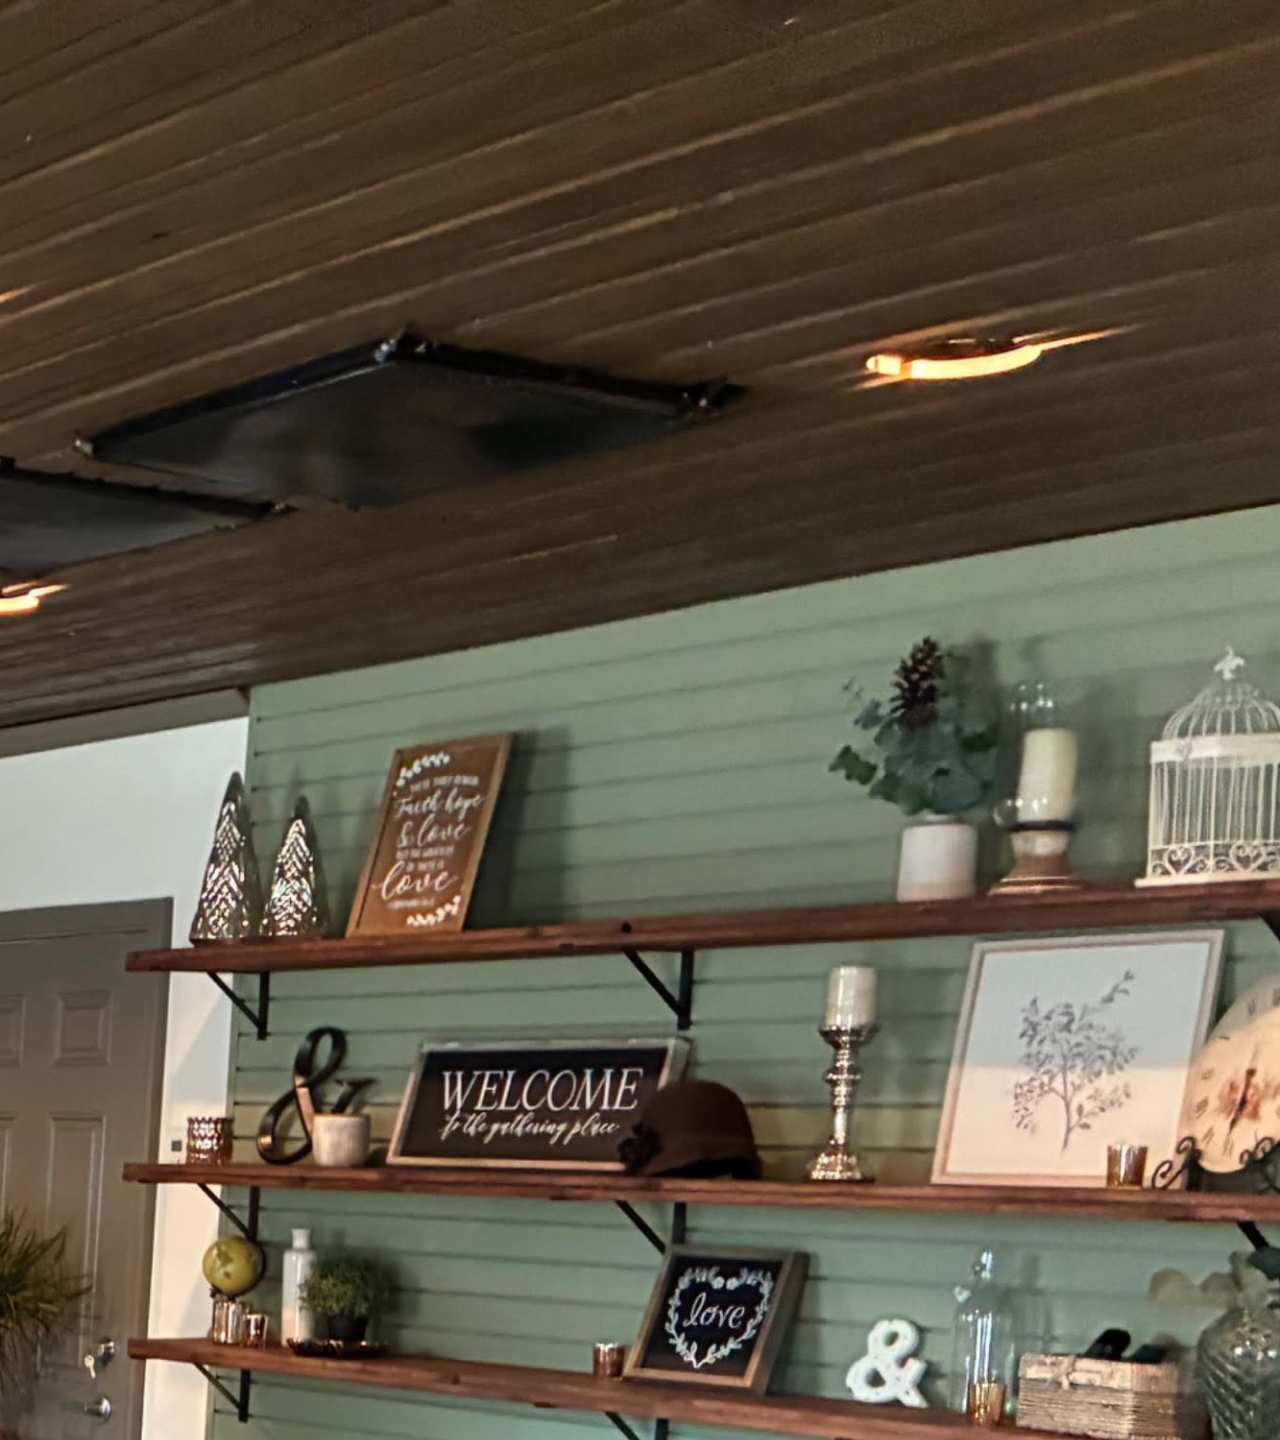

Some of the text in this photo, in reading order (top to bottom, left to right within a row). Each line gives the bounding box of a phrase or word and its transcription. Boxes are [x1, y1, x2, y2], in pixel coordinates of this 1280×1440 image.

[441, 1067, 644, 1112] WELCOME
[462, 1112, 488, 1137] the
[483, 1112, 568, 1146] gathering
[563, 1112, 620, 1146] place
[682, 1292, 746, 1329] love
[846, 1318, 929, 1409] &
